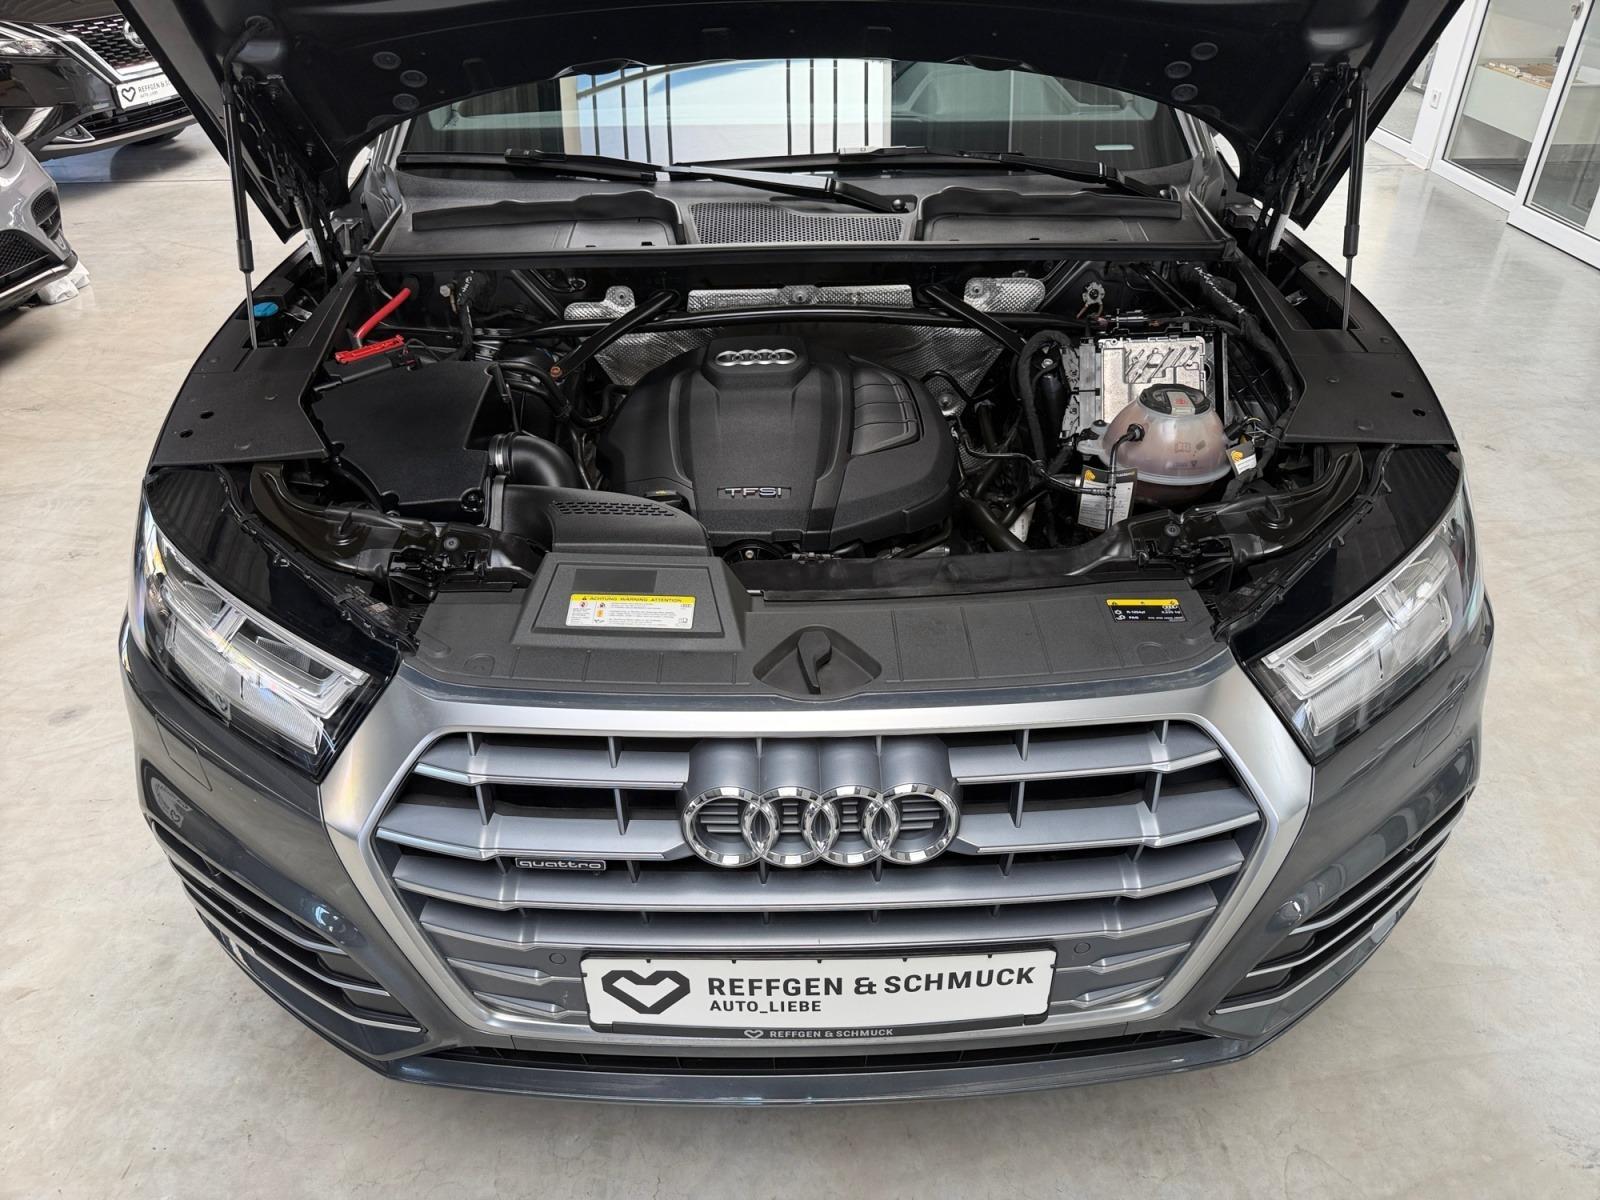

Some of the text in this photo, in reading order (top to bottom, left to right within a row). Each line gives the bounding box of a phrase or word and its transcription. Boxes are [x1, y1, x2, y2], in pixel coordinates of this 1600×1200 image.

[725, 487, 782, 497] TFSI
[519, 860, 602, 869] quattro
[707, 966, 1036, 997] REFFGEN & SCHMUCK
[709, 1000, 822, 1014] AUTO_LIEBE
[769, 1030, 821, 1038] REFFGEN
[836, 1028, 894, 1037] SCHMUCK
